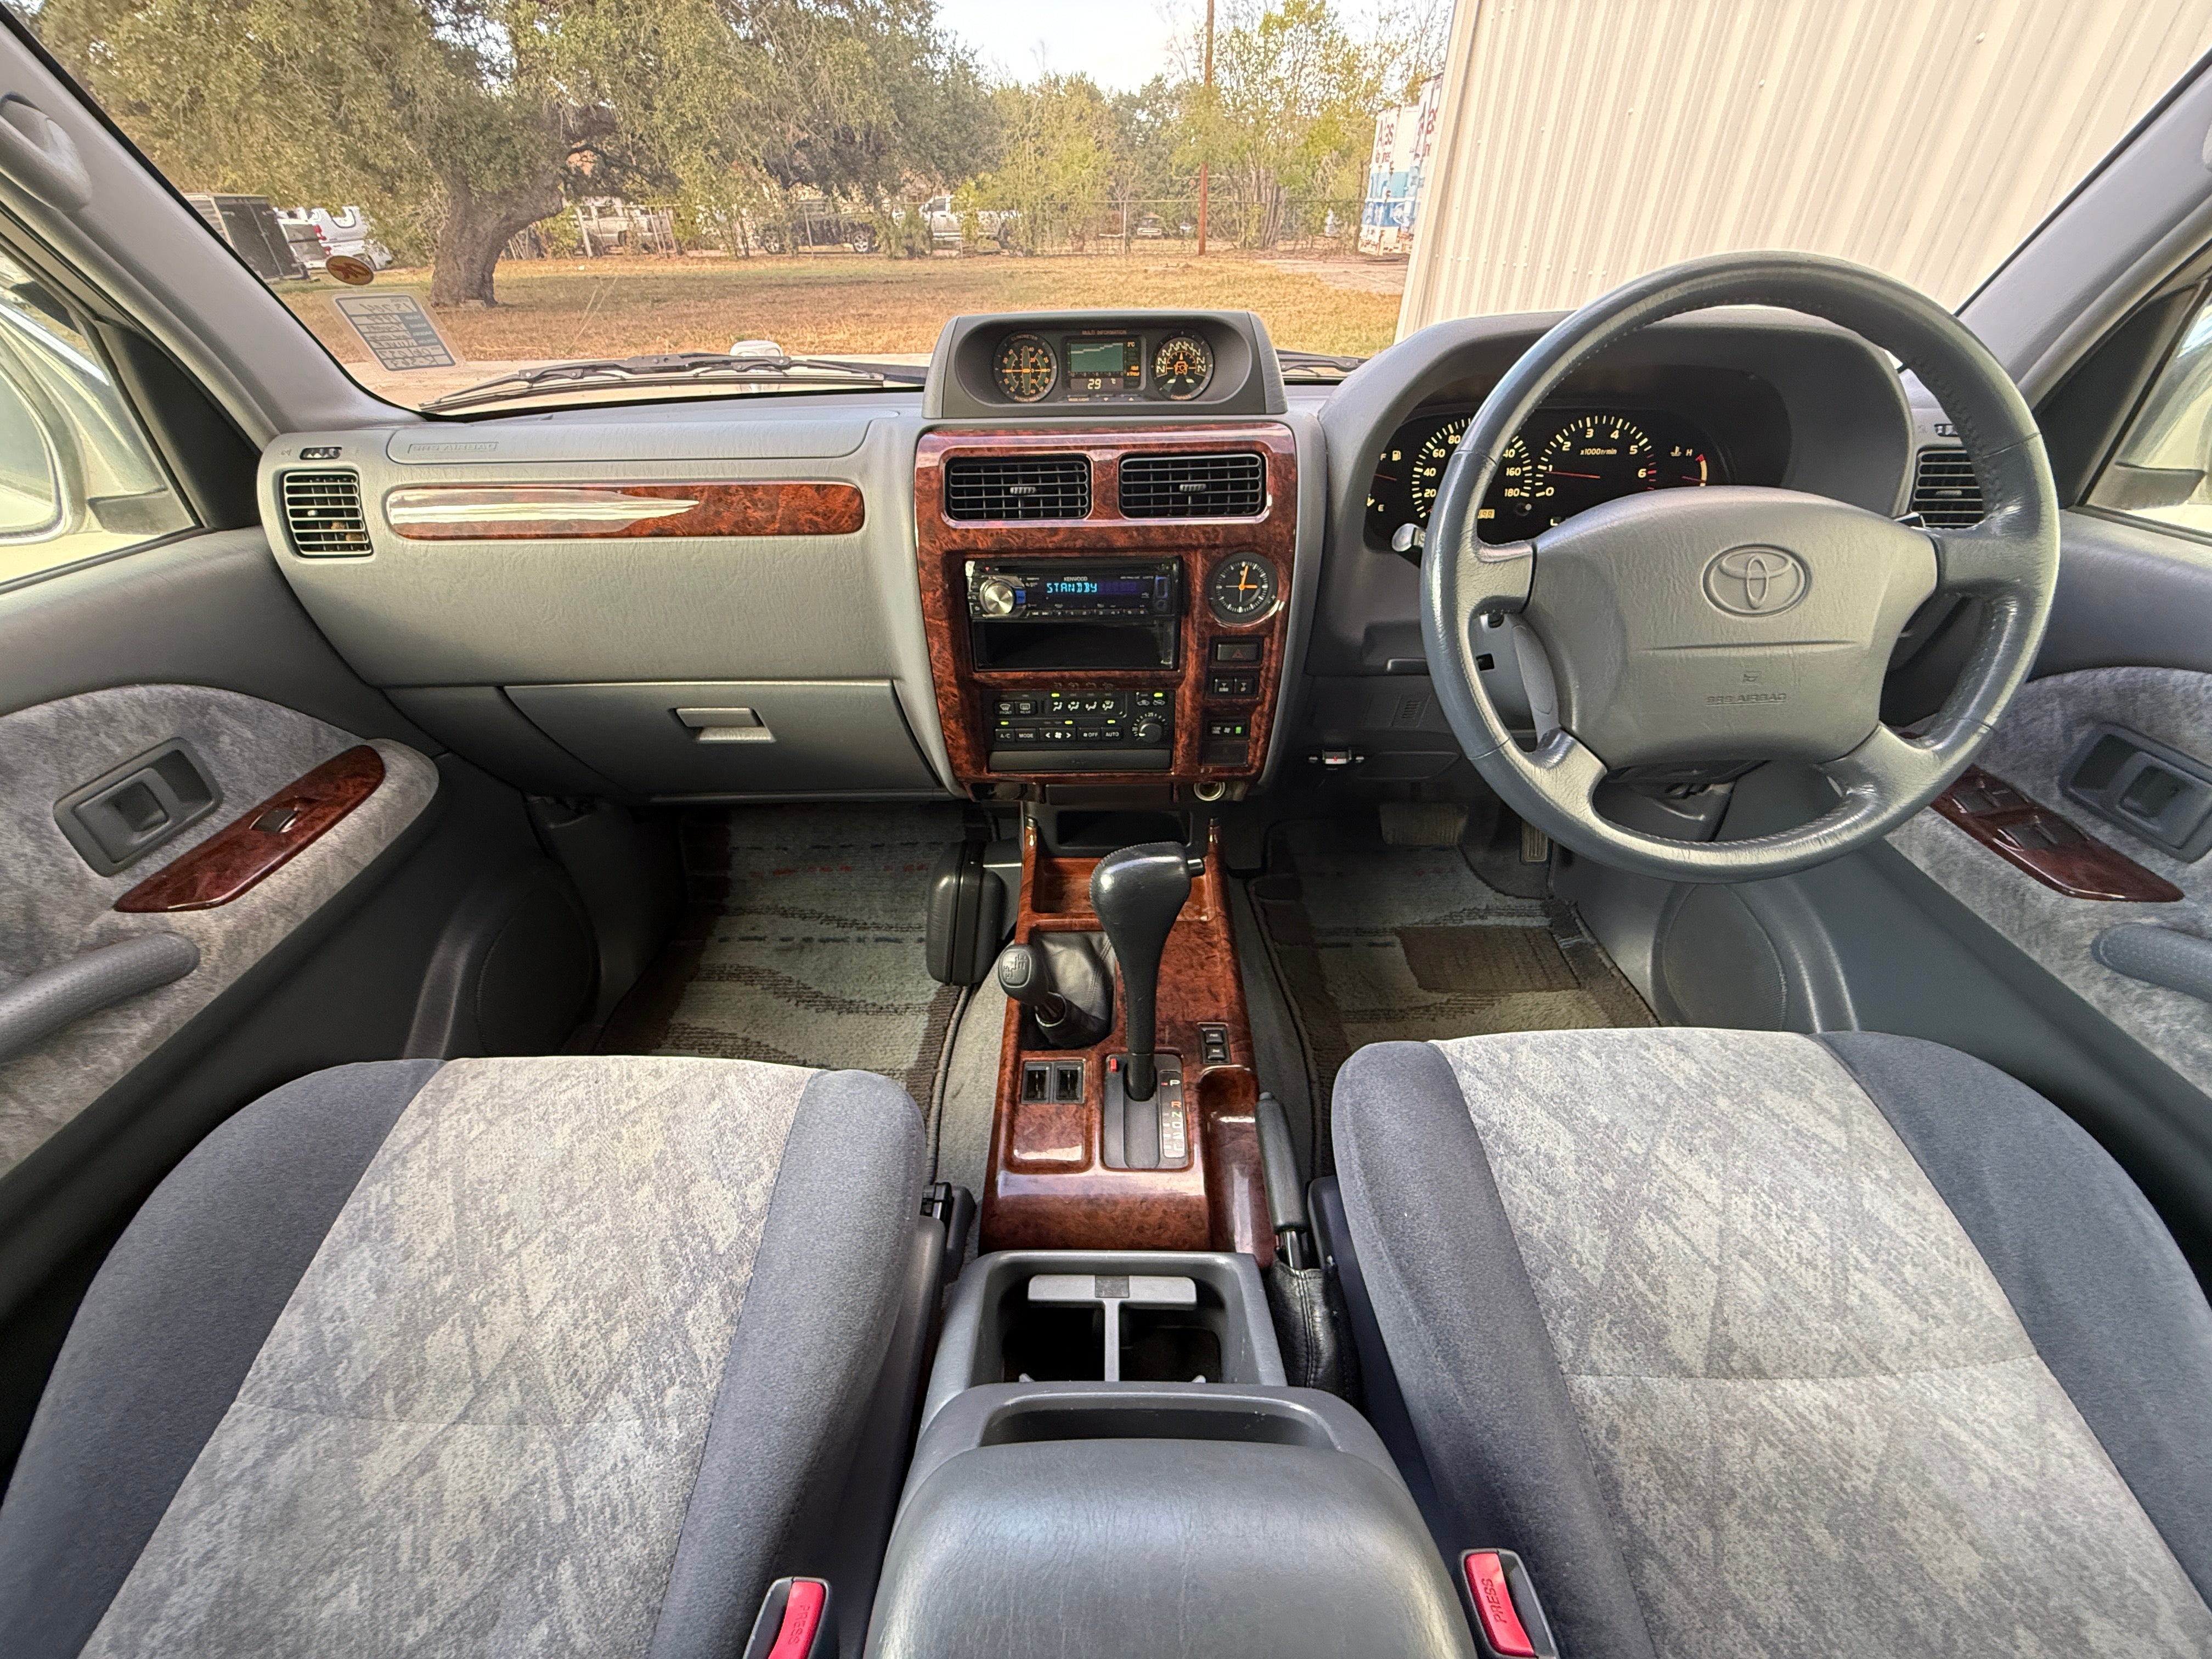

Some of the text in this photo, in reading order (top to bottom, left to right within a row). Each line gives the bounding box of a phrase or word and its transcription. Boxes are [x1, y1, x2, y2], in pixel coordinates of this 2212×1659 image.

[1087, 379, 1102, 390] 29
[1586, 428, 1594, 438] 3
[1611, 430, 1619, 439] 4
[1448, 435, 1461, 444] 80
[1562, 442, 1571, 451] 2
[1629, 445, 1638, 455] 5
[1432, 449, 1446, 458] 60
[1503, 449, 1515, 458] 40
[1424, 468, 1436, 477] 40
[1506, 467, 1521, 476] 160
[1638, 469, 1646, 478] 6
[1424, 489, 1436, 498] 20
[1504, 488, 1520, 497] 180
[1546, 487, 1554, 496] 0
[1046, 582, 1097, 594] STANDBY
[1737, 693, 1787, 702] AIRBAG
[1481, 1578, 1507, 1624] PRESS
[788, 1605, 810, 1645] PRESS
